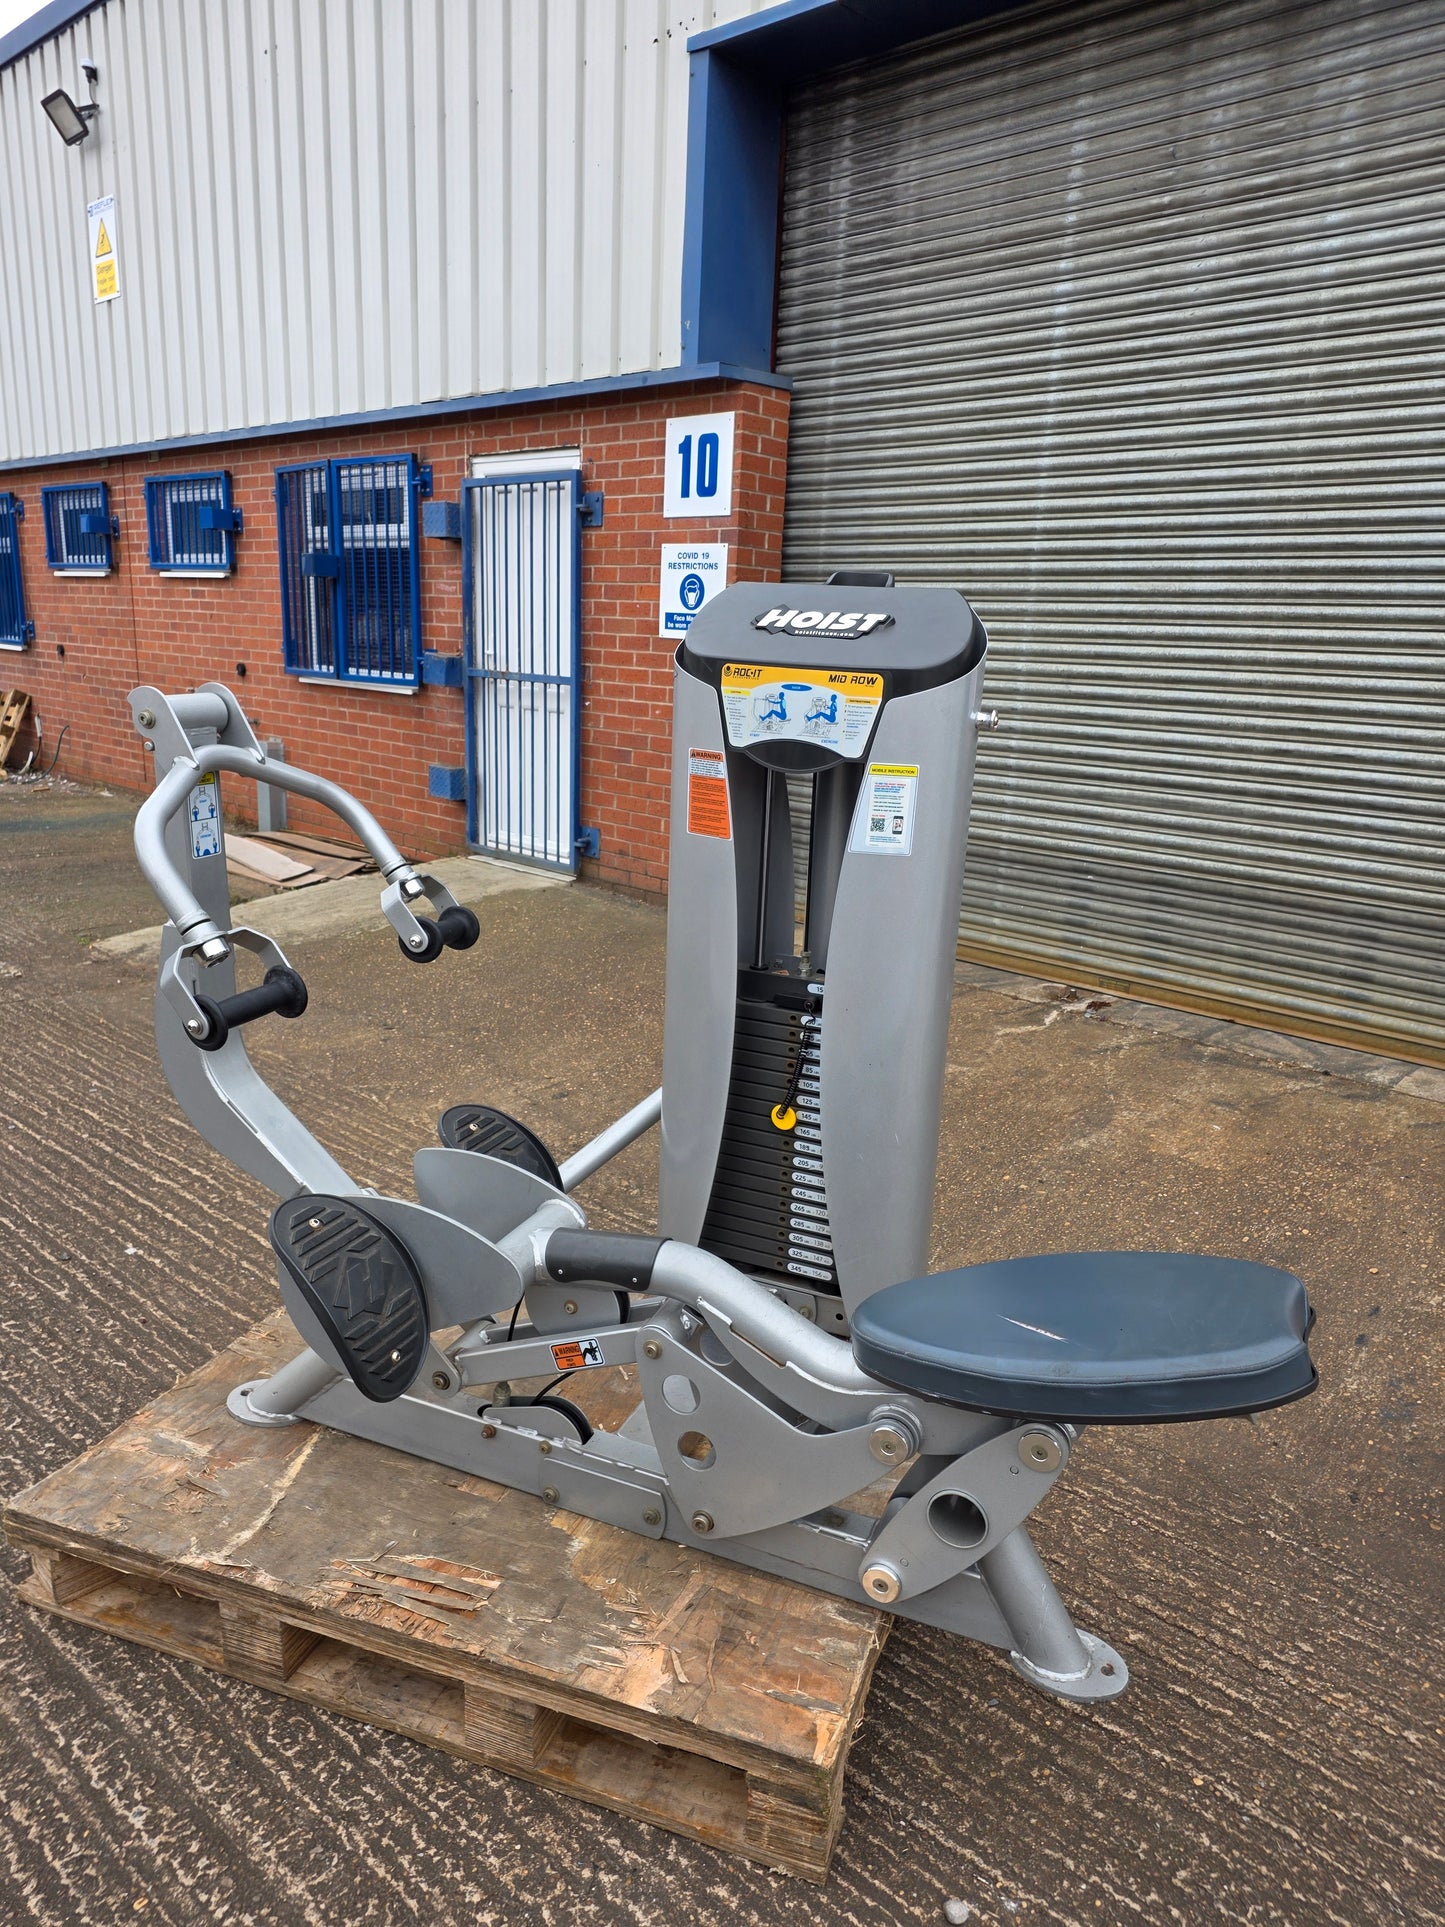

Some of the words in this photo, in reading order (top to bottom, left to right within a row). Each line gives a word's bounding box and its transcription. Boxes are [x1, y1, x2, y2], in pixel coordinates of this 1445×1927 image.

[678, 432, 719, 498] 10
[677, 552, 698, 560] COVID
[702, 552, 710, 560] 19
[668, 562, 719, 570] RESTRICTIONS
[673, 614, 685, 622] Face
[756, 609, 887, 632] HOIST
[828, 674, 847, 684] MID
[850, 675, 878, 685] ROW
[695, 752, 721, 760] WARNING
[805, 1066, 814, 1074] 85
[803, 1081, 814, 1089] 105
[802, 1097, 813, 1105] 125
[800, 1128, 811, 1136] 165
[797, 1159, 809, 1167] 205
[795, 1174, 807, 1182] 225
[795, 1189, 807, 1197] 245
[793, 1204, 806, 1212] 265
[815, 1209, 826, 1217] 120
[793, 1220, 805, 1228] 285
[815, 1224, 826, 1232] 129
[791, 1250, 803, 1258] 325
[790, 1265, 802, 1273] 345
